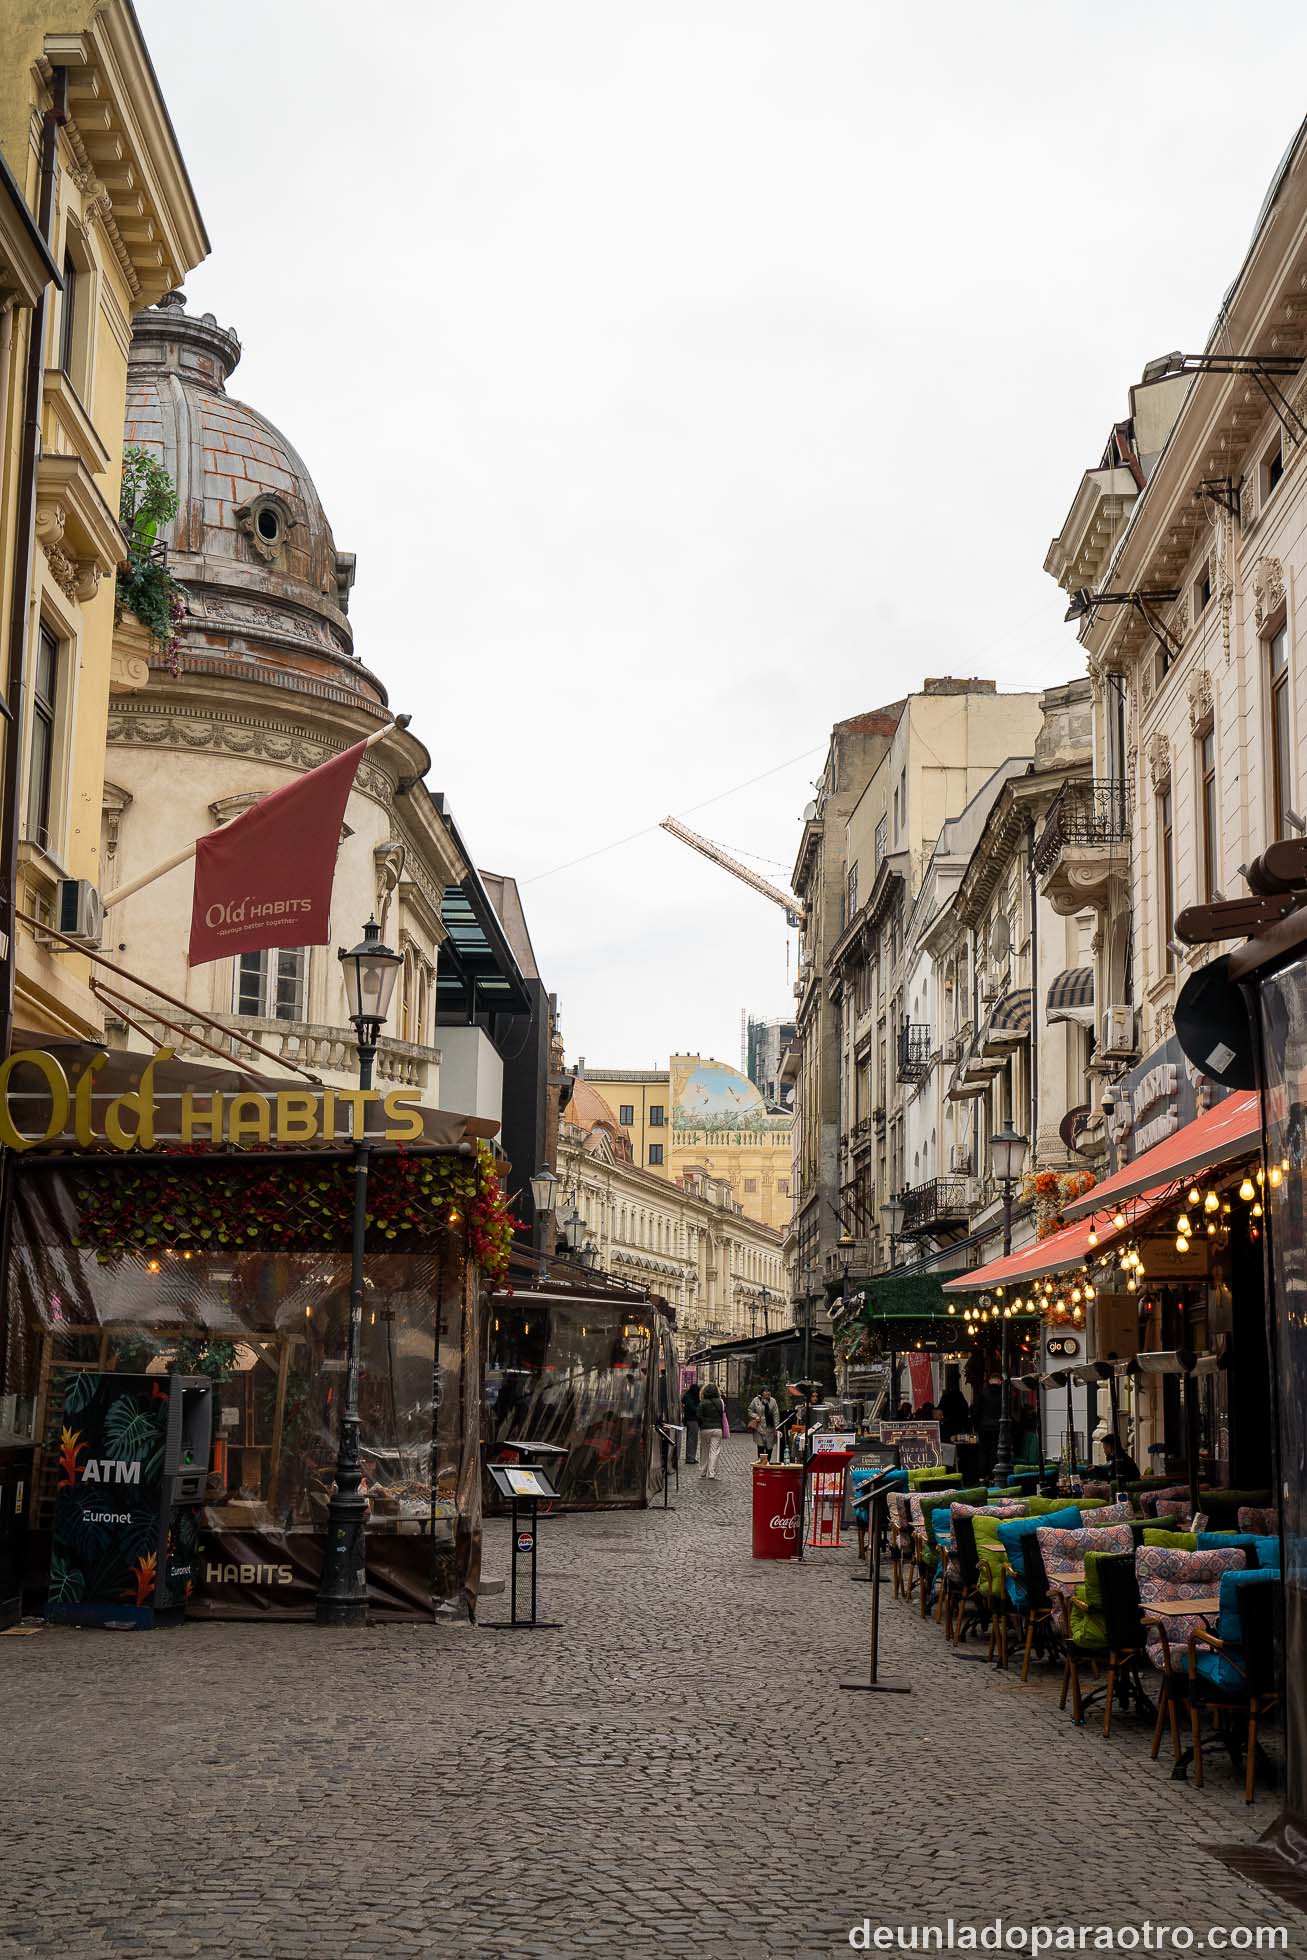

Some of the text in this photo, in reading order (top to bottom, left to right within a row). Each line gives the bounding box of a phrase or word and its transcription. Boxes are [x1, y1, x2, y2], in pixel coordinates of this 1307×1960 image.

[206, 897, 312, 928] Old HABITS
[244, 922, 264, 930] better
[0, 1047, 425, 1150] Old HABITS
[81, 1459, 141, 1484] ATM
[83, 1510, 132, 1524] Euronet
[170, 1566, 191, 1576] Euronet
[206, 1563, 293, 1584] HABITS
